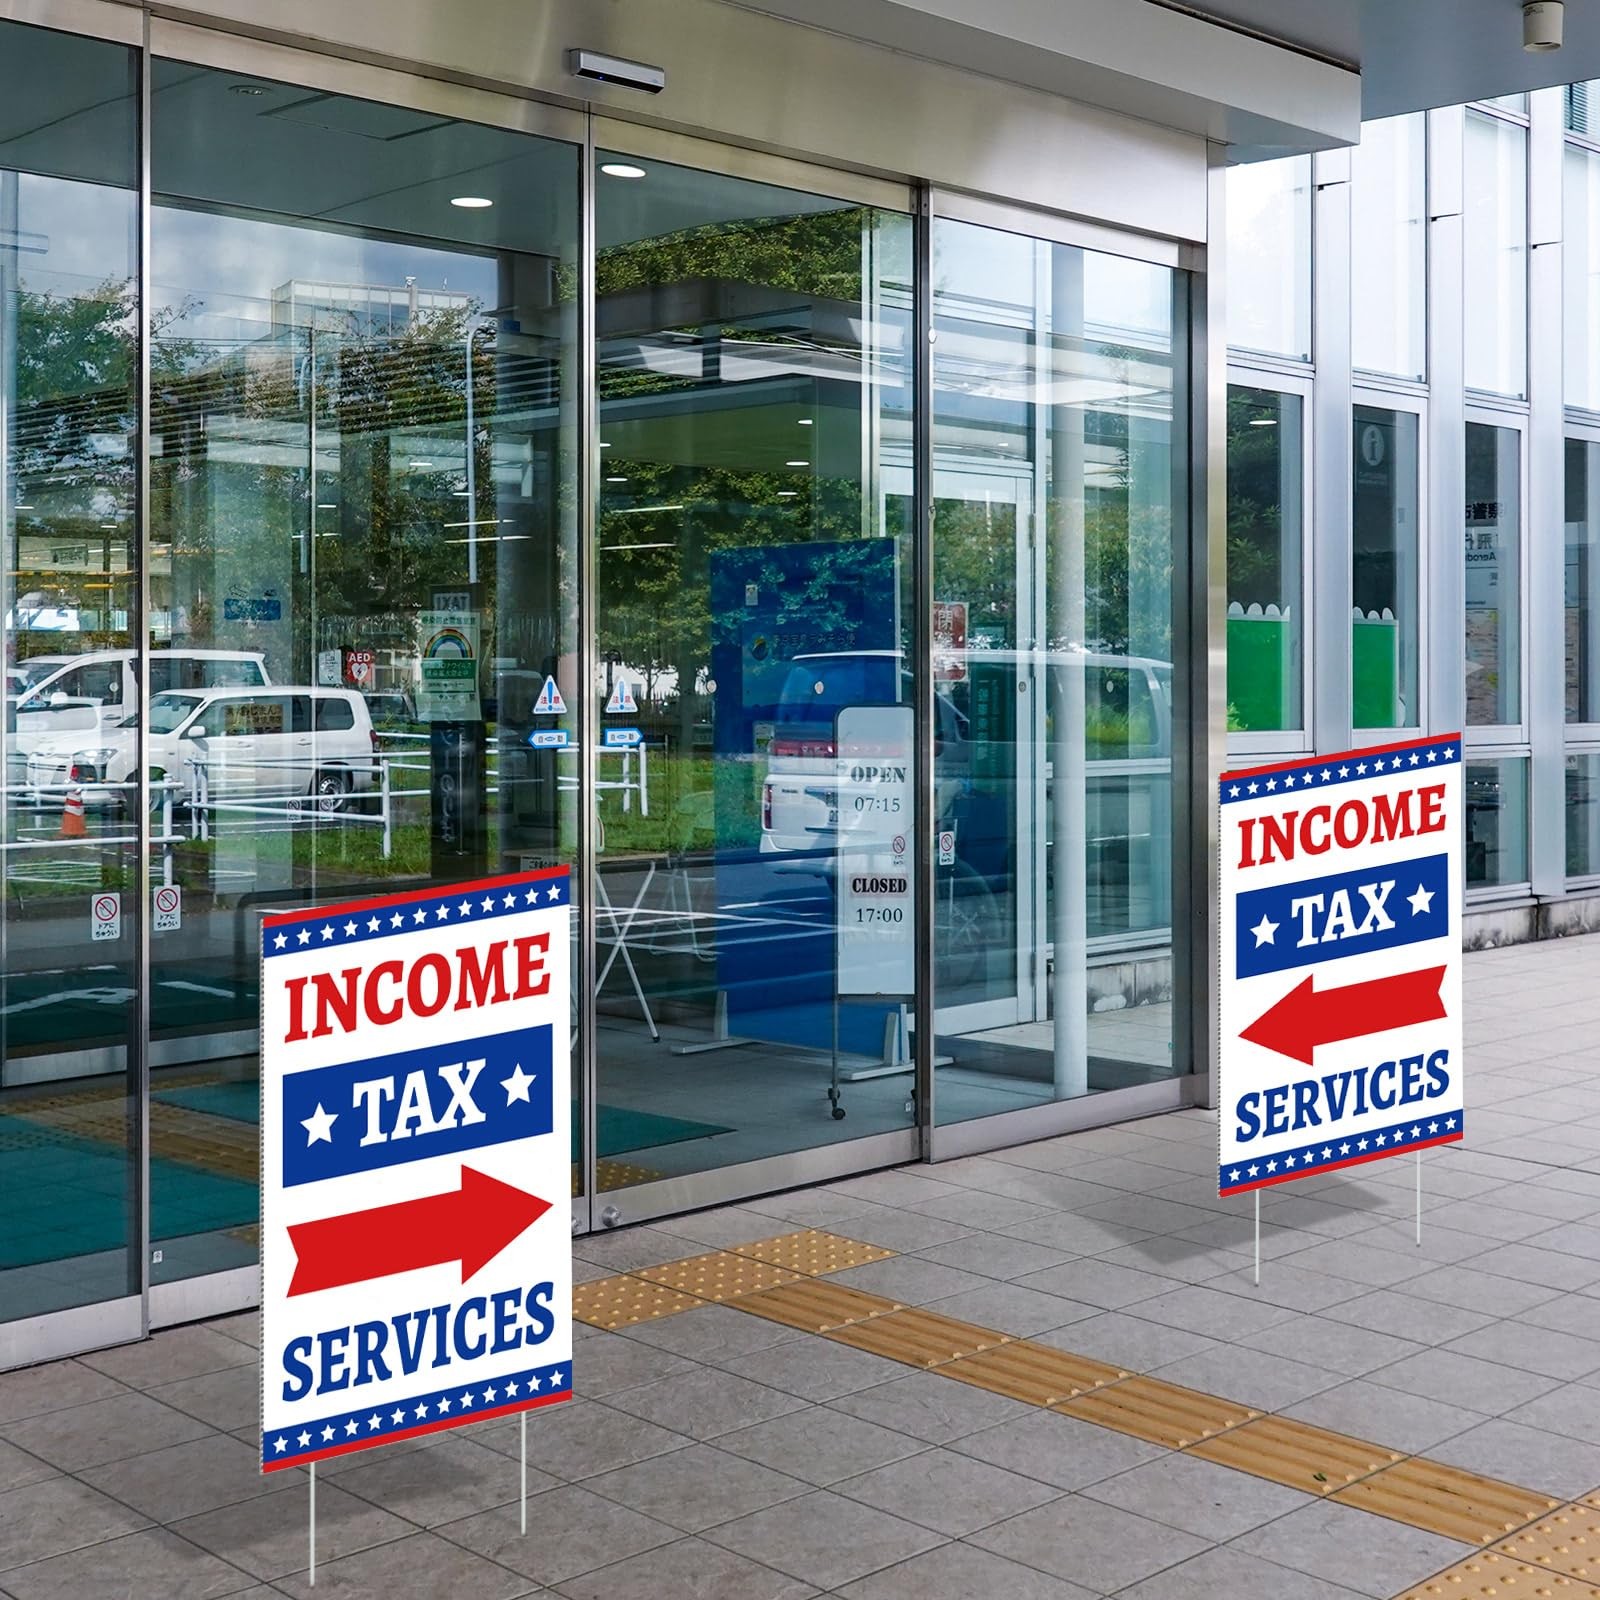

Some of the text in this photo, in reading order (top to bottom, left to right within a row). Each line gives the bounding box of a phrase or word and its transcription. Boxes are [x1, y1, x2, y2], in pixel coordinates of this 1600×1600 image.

[349, 652, 371, 662] AED
[850, 766, 907, 783] OPEN
[854, 796, 901, 813] 07:15
[1237, 783, 1447, 870] INCOME
[852, 877, 907, 893] CLOSED
[856, 907, 903, 923] 17:00
[1291, 879, 1396, 949] TAX
[284, 931, 551, 1044] INCOME
[352, 1057, 487, 1148] TAX
[1235, 1049, 1450, 1143] SERVICES
[281, 1281, 556, 1402] SERVICES
